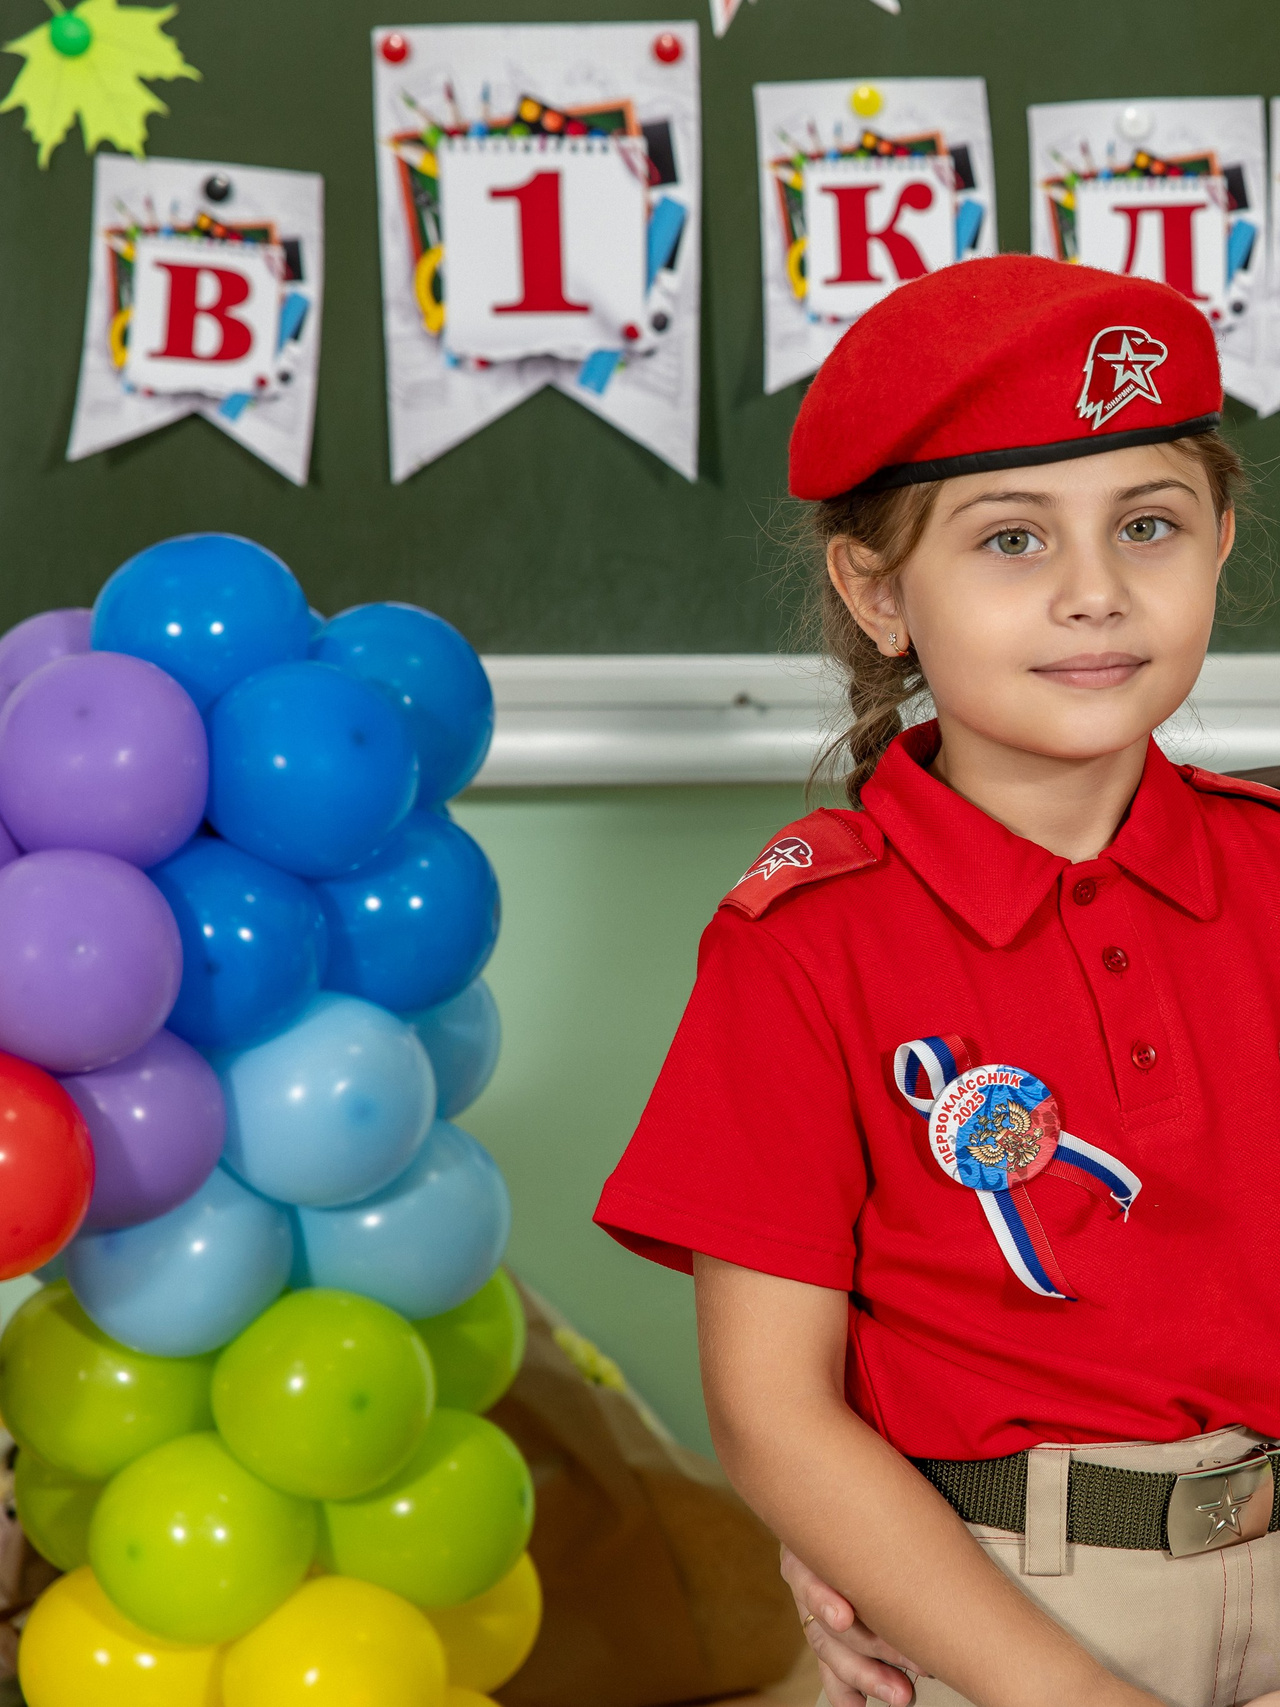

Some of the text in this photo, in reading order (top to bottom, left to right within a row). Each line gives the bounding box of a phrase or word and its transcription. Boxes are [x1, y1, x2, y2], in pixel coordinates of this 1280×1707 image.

[147, 260, 253, 363] В
[490, 169, 592, 316] 1
[1104, 384, 1136, 411] ЮНАРМИЯ
[935, 1073, 1022, 1164] ПЕРВОКЛАССНИК
[953, 1092, 985, 1126] 2025
